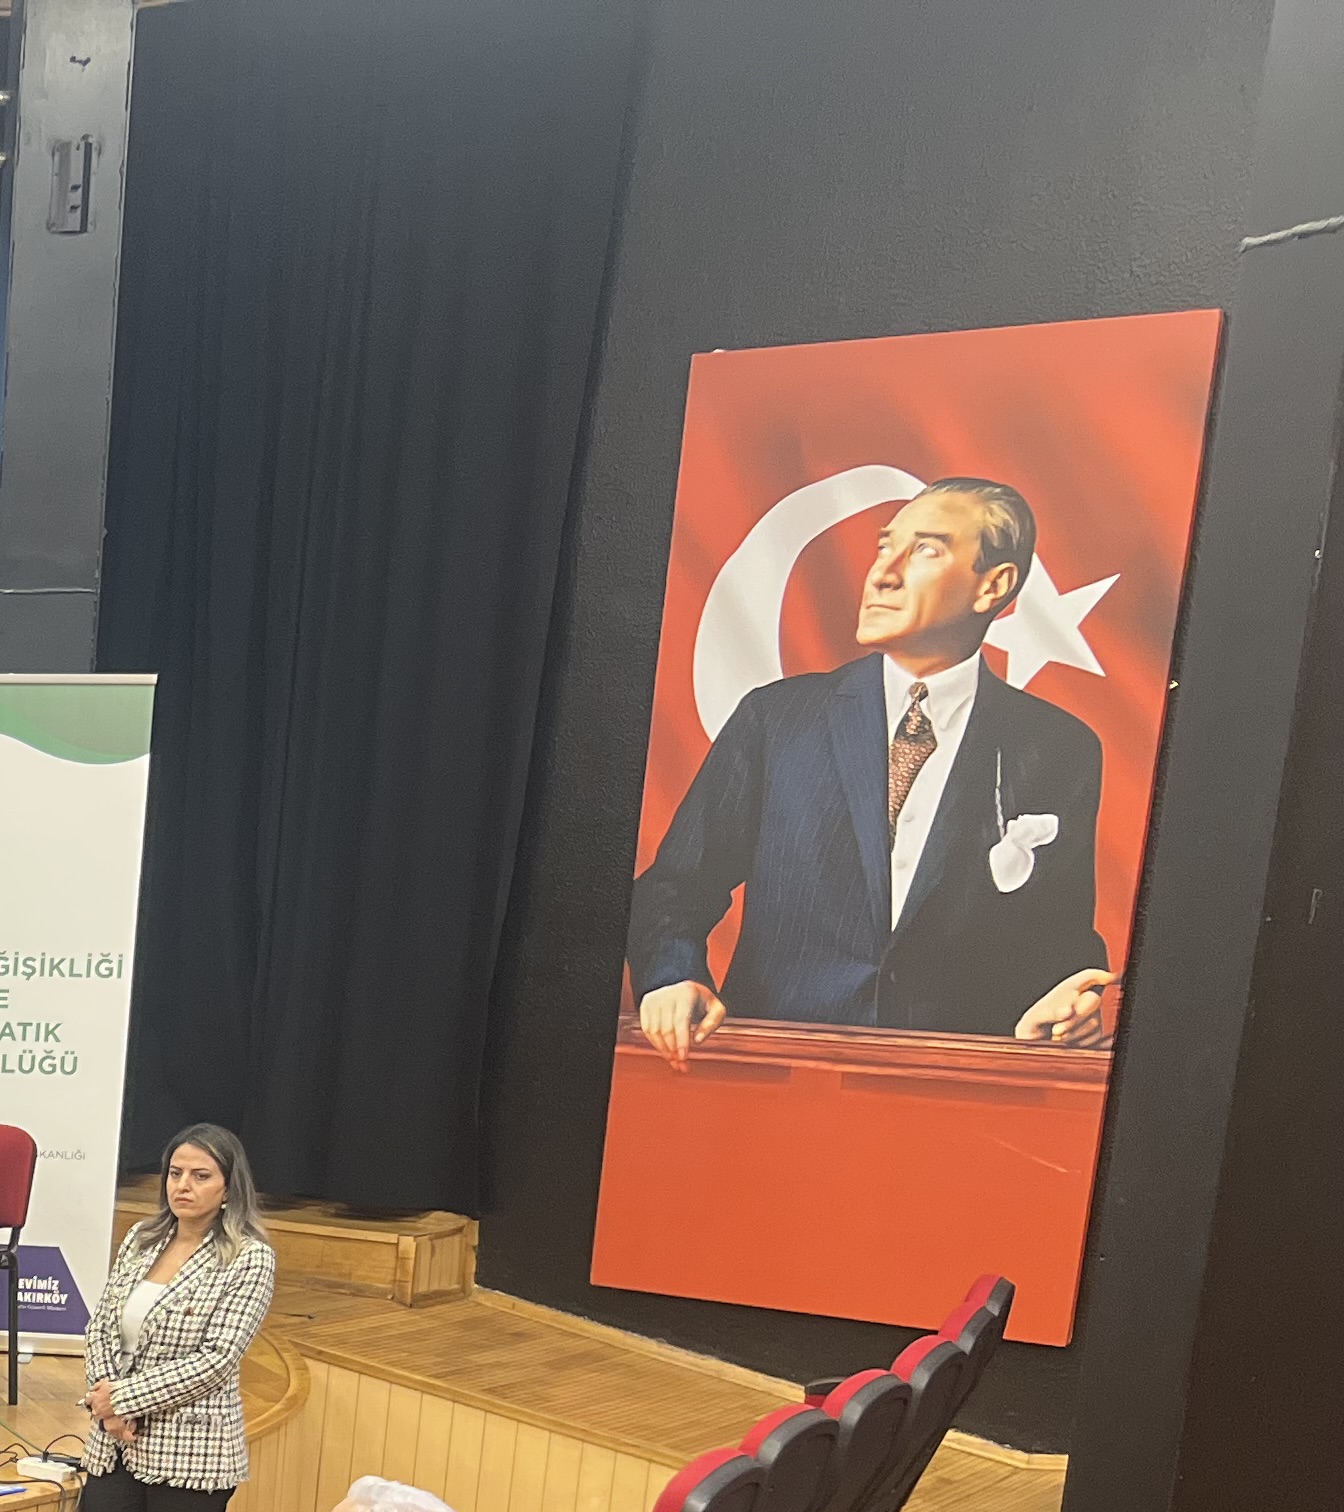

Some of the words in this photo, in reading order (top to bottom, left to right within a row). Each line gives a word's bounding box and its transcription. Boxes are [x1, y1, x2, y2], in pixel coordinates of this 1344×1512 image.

[39, 1148, 86, 1161] KANLIĞI
[17, 1275, 60, 1290] EVİMİZ
[16, 1289, 69, 1305] AKIRKÖY
